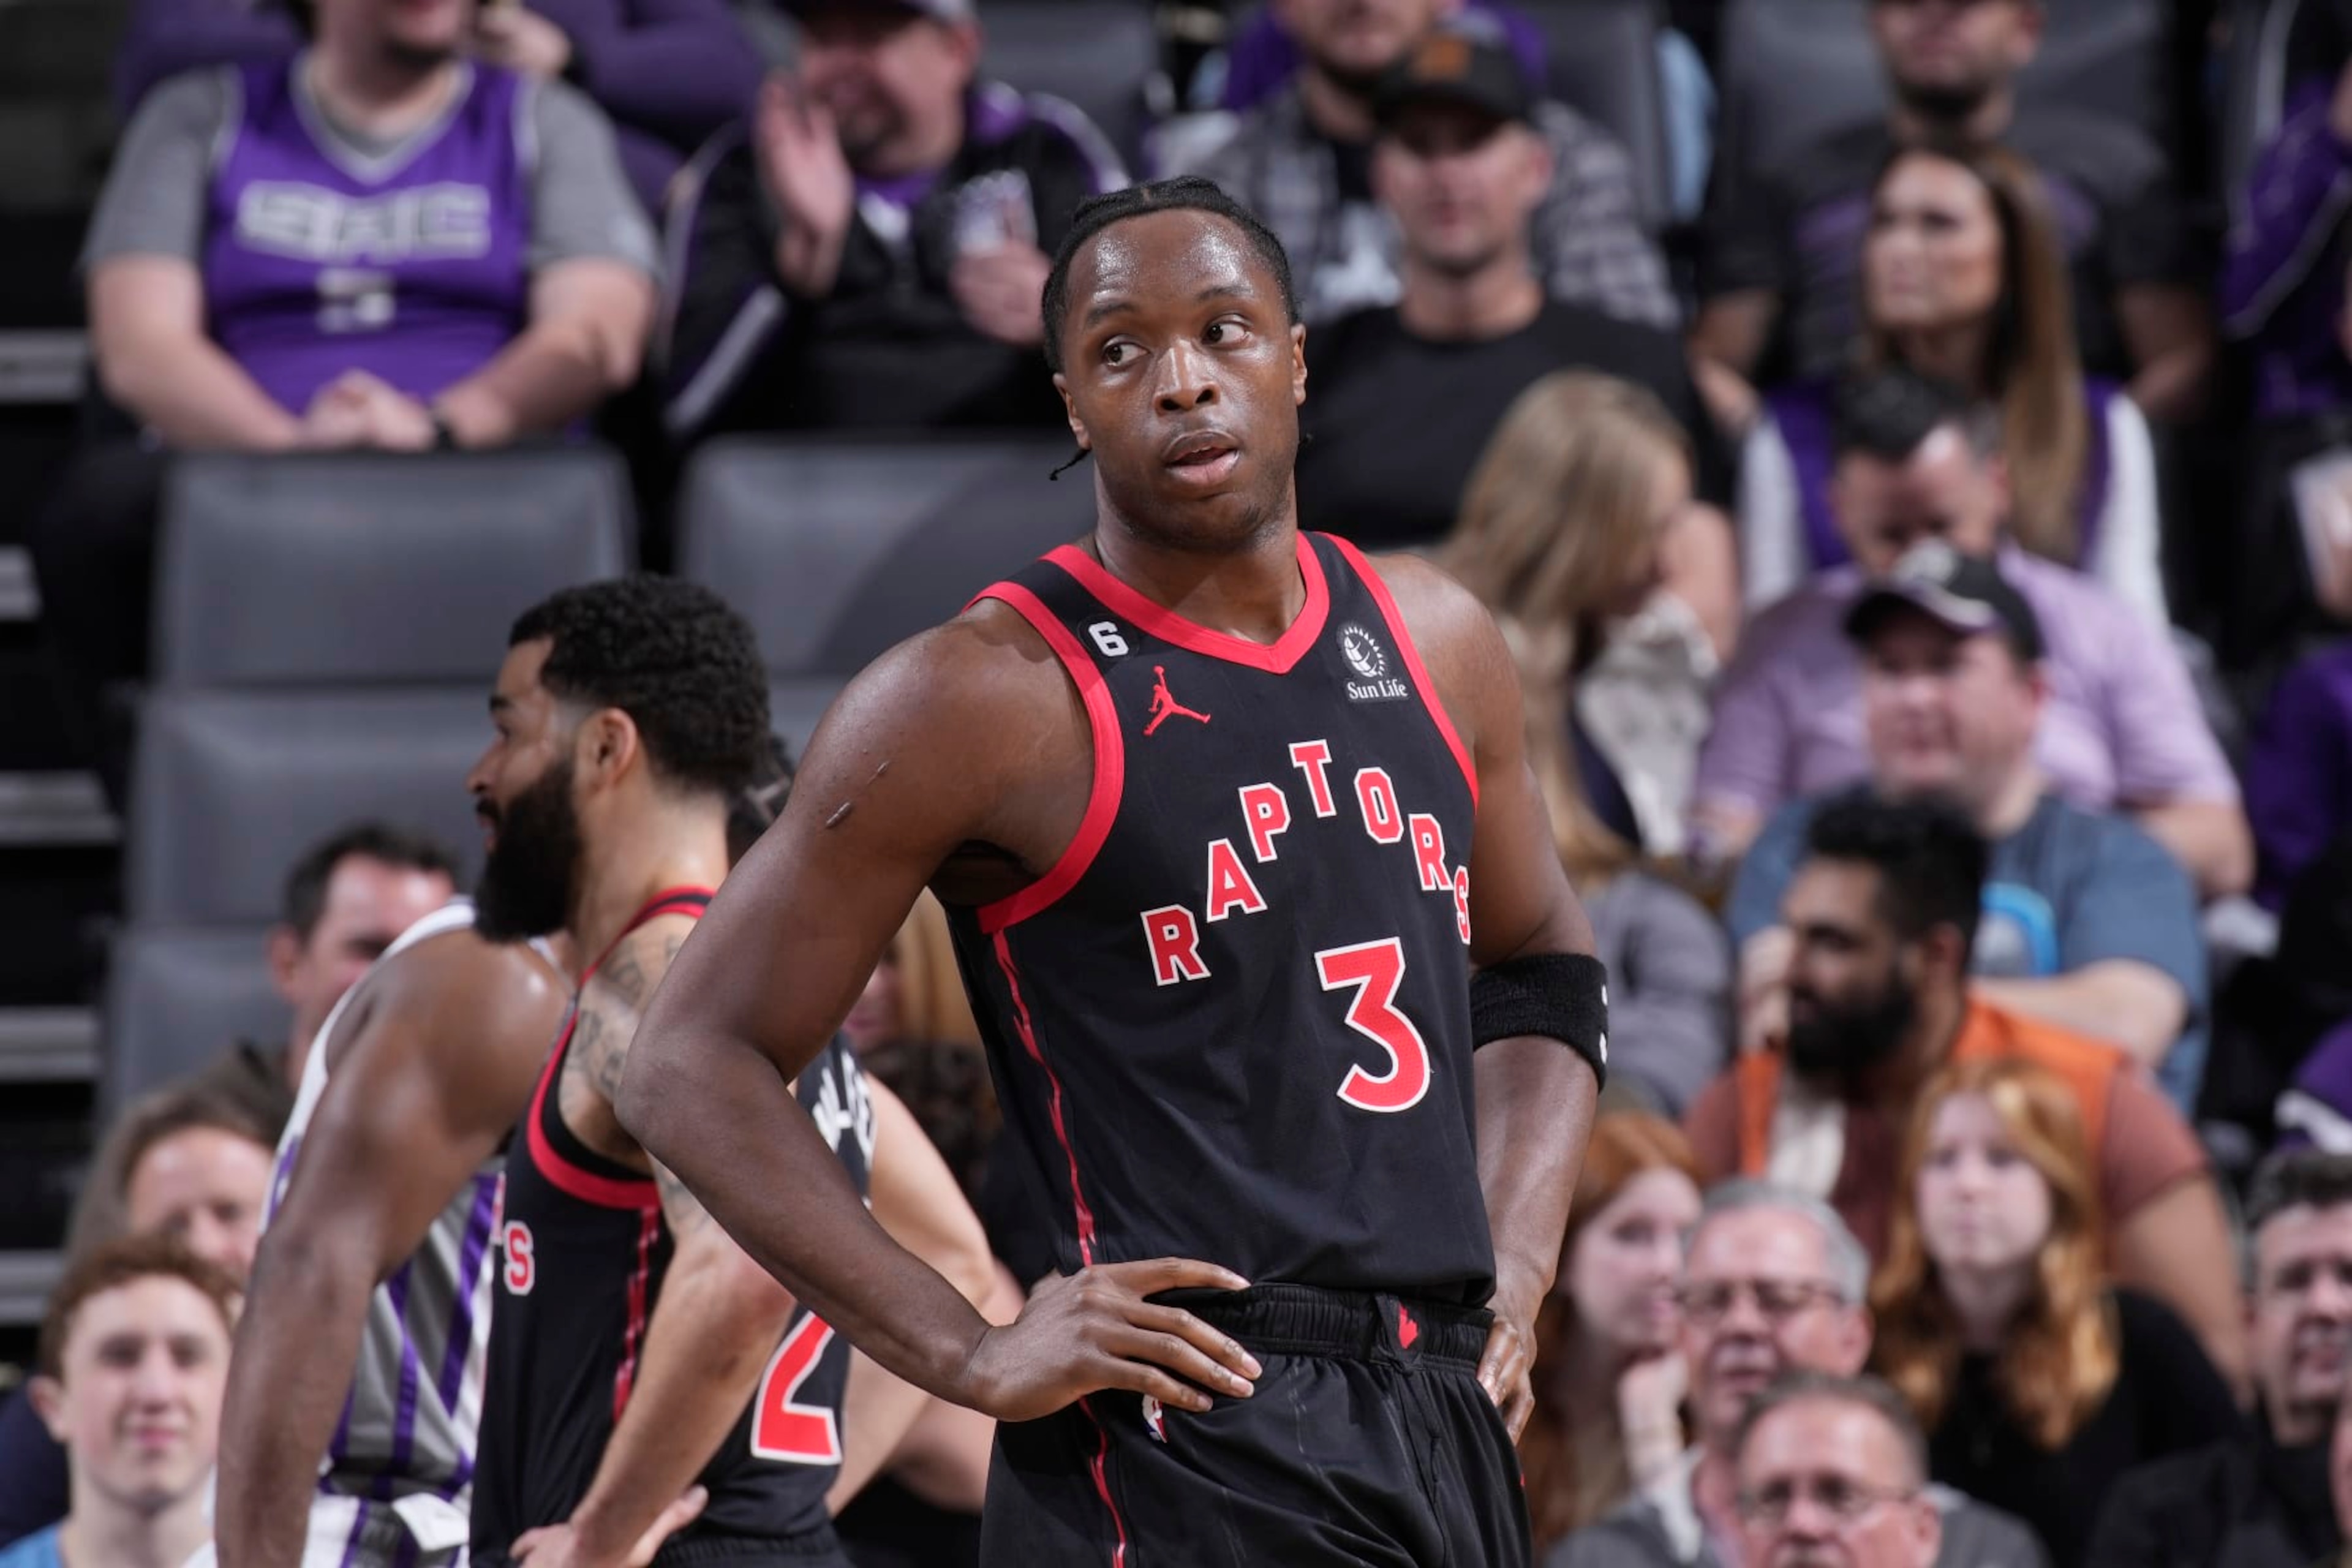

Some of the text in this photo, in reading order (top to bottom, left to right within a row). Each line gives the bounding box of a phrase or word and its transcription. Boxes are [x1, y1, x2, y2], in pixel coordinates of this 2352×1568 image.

[1087, 621, 1129, 657] 6
[1348, 679, 1408, 699] Sun Life
[1140, 739, 1471, 987] RAPTORS
[1315, 937, 1430, 1113] 3
